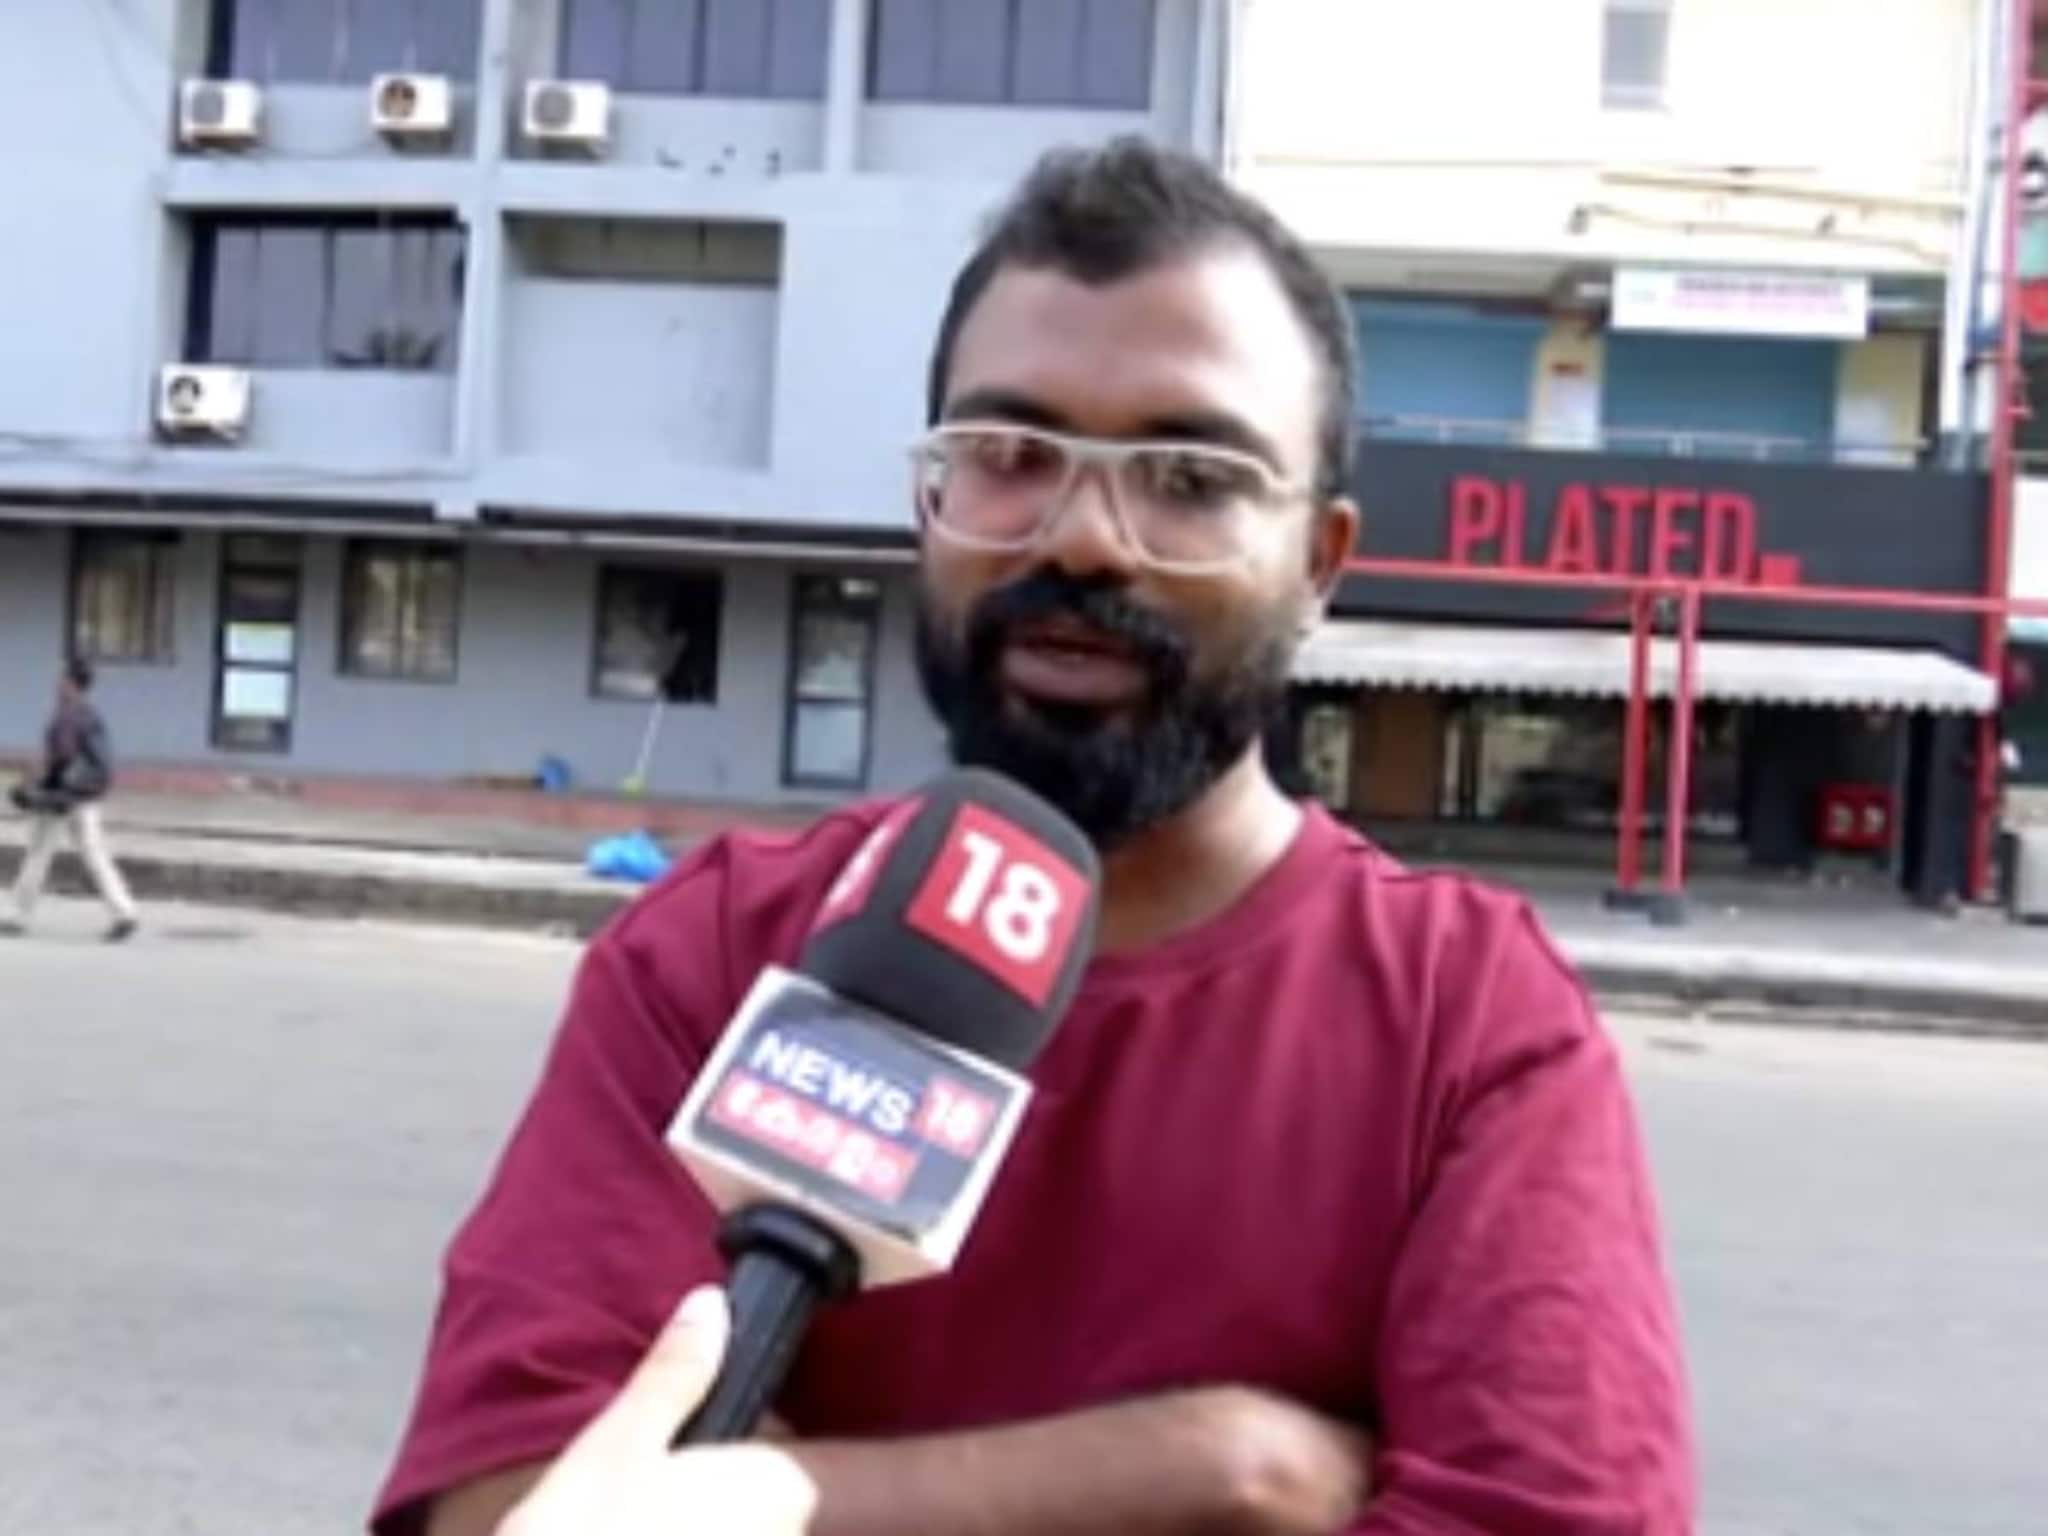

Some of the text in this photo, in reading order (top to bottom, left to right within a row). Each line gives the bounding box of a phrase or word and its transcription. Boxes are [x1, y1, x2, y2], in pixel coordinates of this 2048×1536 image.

[1450, 475, 1757, 586] PLATED
[945, 830, 1060, 961] 18
[749, 1031, 982, 1146] NEWS 18
